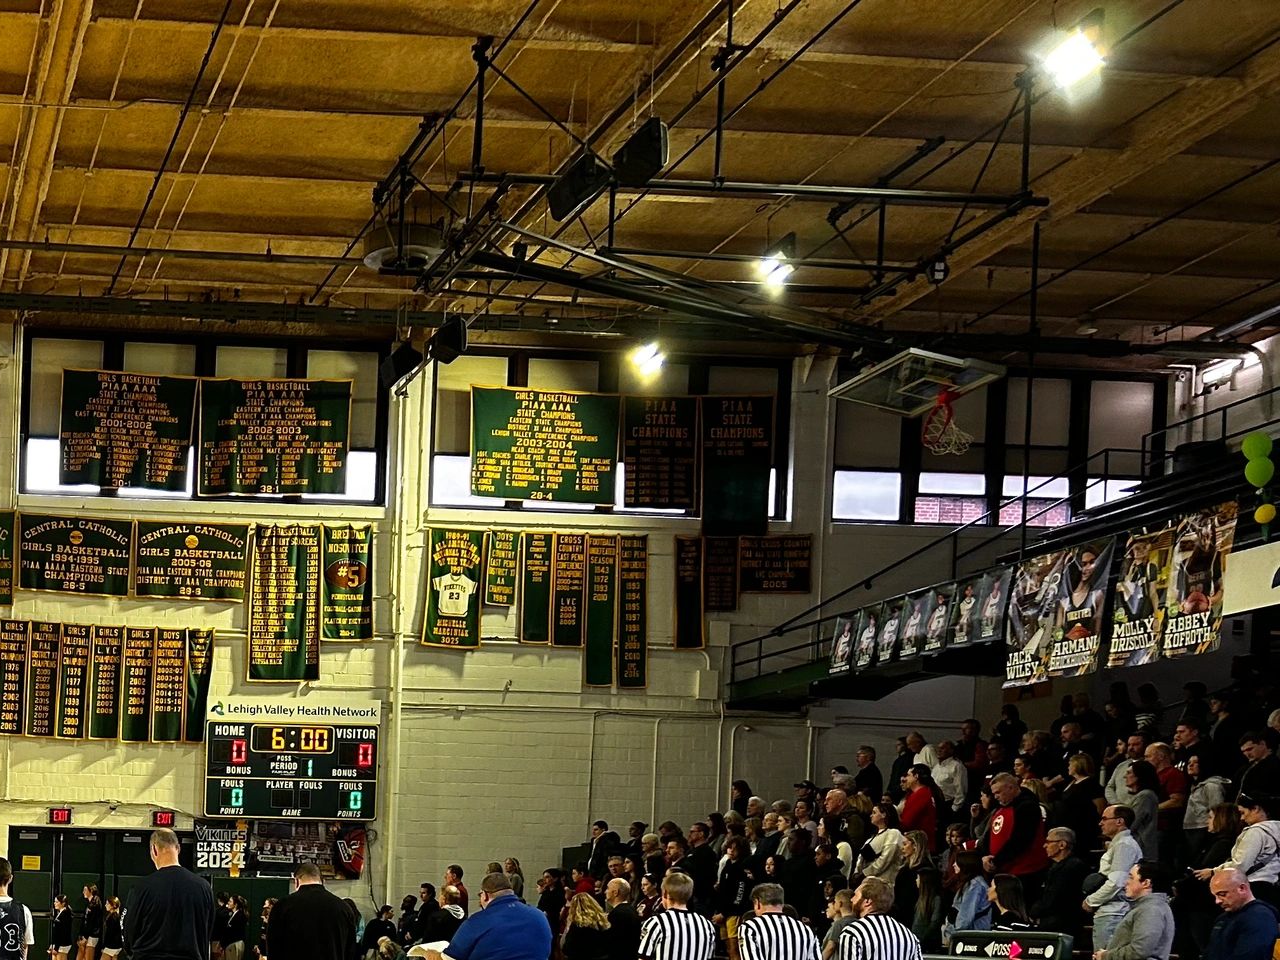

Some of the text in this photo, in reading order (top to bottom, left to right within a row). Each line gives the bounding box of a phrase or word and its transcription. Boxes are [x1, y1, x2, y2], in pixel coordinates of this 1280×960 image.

[515, 392, 578, 403] GIRLS BASKETBALL
[522, 401, 571, 411] PIAA AAA
[517, 409, 575, 420] STATE CHAMPIONS
[101, 419, 152, 429] 2001-2002
[517, 439, 572, 449] 2003-2004
[25, 521, 128, 545] CENTRAL CATHOLIC
[141, 526, 244, 547] CENTRAL CATHOLIC
[22, 543, 128, 558] GIRLS BASKETBALL
[140, 548, 243, 560] GIRLS BASKETBALL
[52, 554, 99, 564] 1994-1995
[171, 559, 211, 567] 2005-06
[22, 560, 128, 575] PIAA AAAA EASTERN STATE
[45, 571, 104, 582] CHAMPIONS
[137, 576, 169, 584] DISTRICT
[186, 578, 199, 586] AAA
[204, 579, 244, 588] CHAMPIONS
[338, 566, 359, 587] #5
[63, 582, 85, 590] 26-5
[449, 592, 459, 600] 23
[1113, 618, 1153, 638] MOLLY
[1166, 612, 1210, 633] ABBEY
[1110, 633, 1156, 653] DRISCOLL
[1163, 627, 1211, 648] KOFROTH
[1053, 635, 1097, 657] ARMANI
[1007, 650, 1033, 666] JACK
[1007, 663, 1038, 680] WILEY
[228, 704, 377, 717] Lehigh Valley Health Network
[216, 726, 245, 736] HOME
[337, 729, 375, 739] VISITOR
[272, 728, 328, 750] 6:00
[233, 740, 246, 762] 0
[359, 744, 372, 765] 0
[226, 766, 251, 774] BONUS
[271, 762, 297, 770] PERIOD
[308, 759, 312, 776] 1
[332, 769, 357, 777] BONUS
[232, 788, 243, 806] 0
[350, 791, 361, 809] 0
[53, 810, 68, 822] EXIT
[157, 812, 172, 824] EXIT
[195, 828, 247, 841] VIKINGS
[197, 842, 247, 852] CLASS OF
[197, 852, 246, 868] 2024
[993, 943, 1012, 956] POSS
[1028, 947, 1043, 955] BONUS
